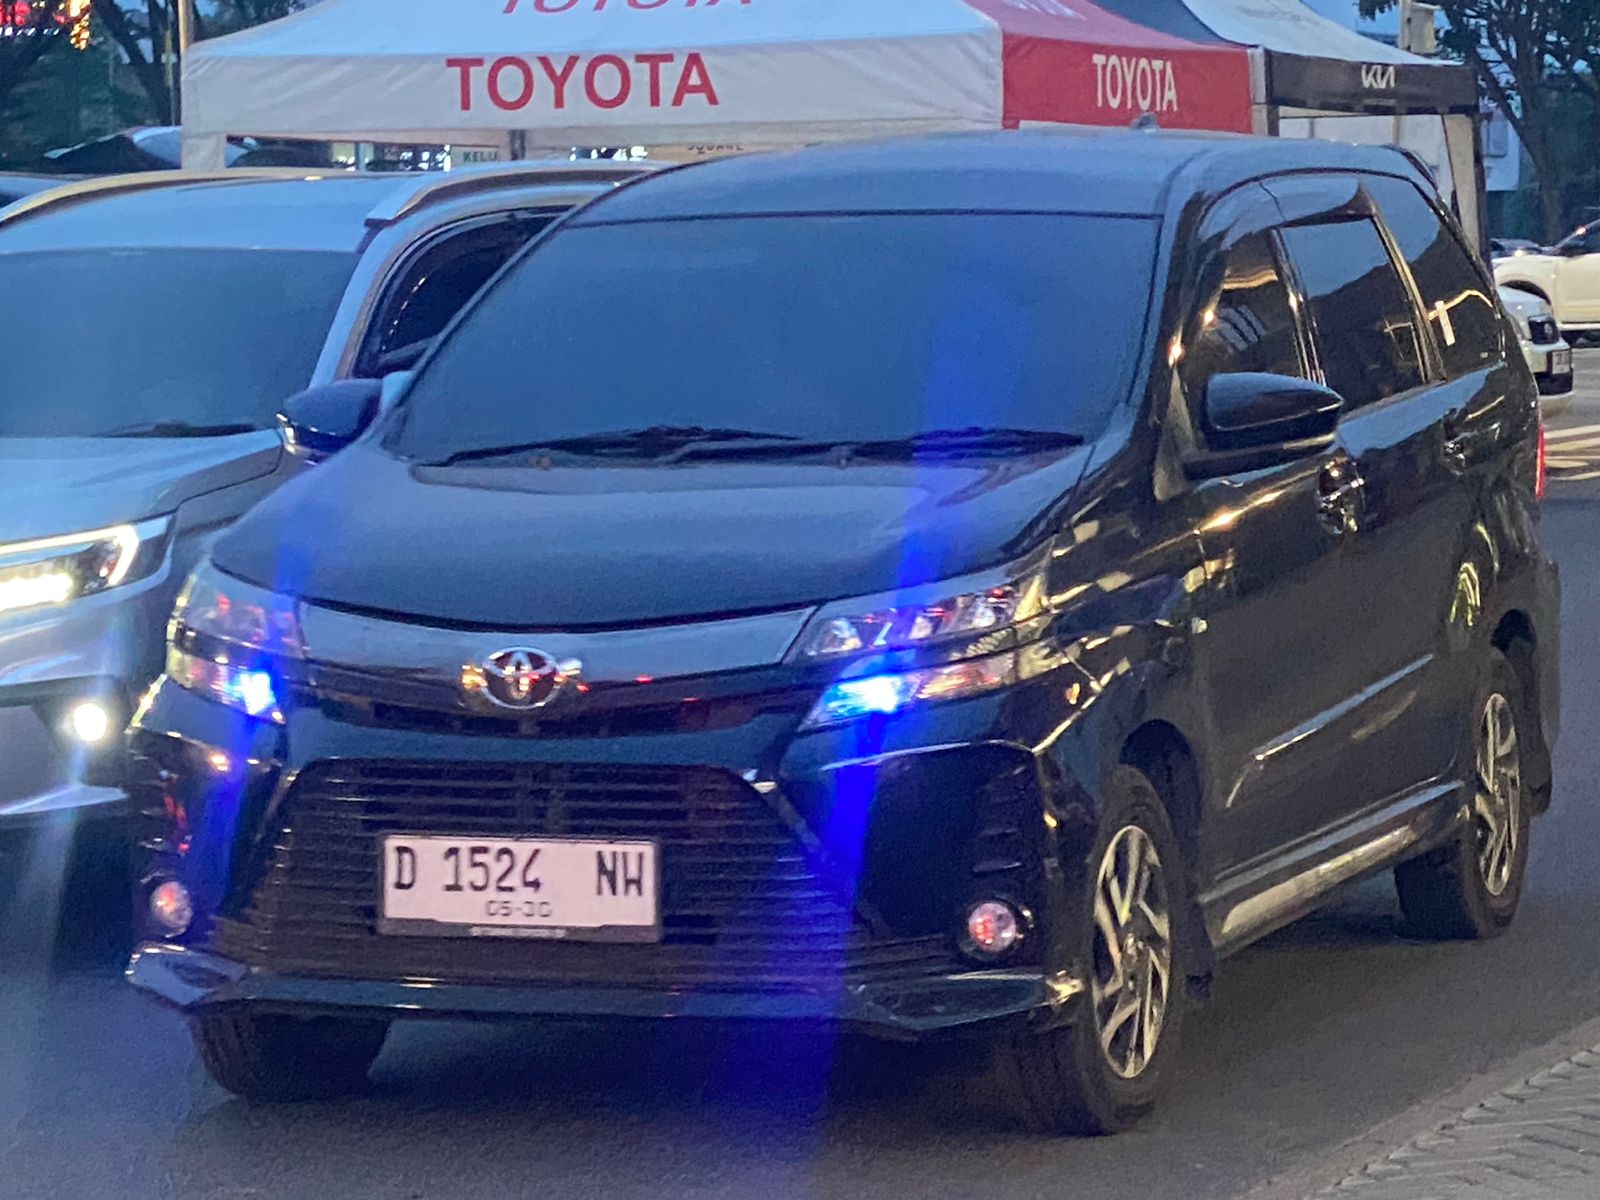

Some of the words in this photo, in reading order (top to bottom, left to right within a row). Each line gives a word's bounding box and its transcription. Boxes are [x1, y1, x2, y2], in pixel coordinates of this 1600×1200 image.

[446, 53, 719, 111] TOYOTA
[1092, 53, 1178, 112] TOYOTA
[394, 846, 416, 890] D
[443, 846, 542, 892] 1524
